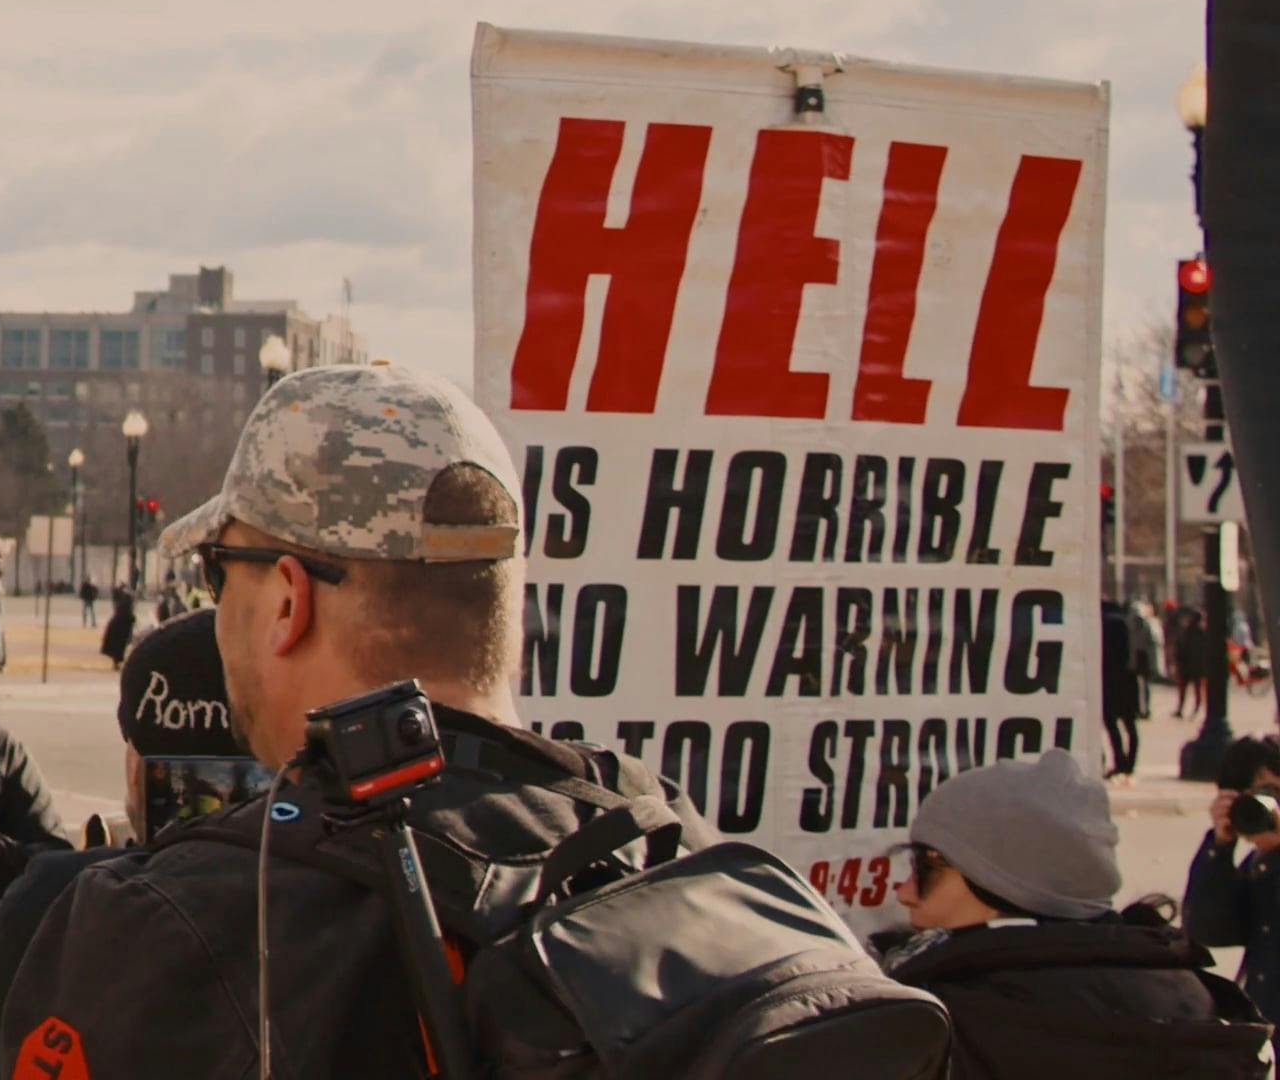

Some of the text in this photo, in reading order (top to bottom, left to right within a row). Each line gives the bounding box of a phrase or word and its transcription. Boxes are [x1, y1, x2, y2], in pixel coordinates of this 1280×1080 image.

[510, 117, 1083, 431] HELL
[523, 446, 1071, 566] IS HORRIBLE
[520, 583, 1064, 697] NO WARNING
[799, 718, 1074, 832] STRO
